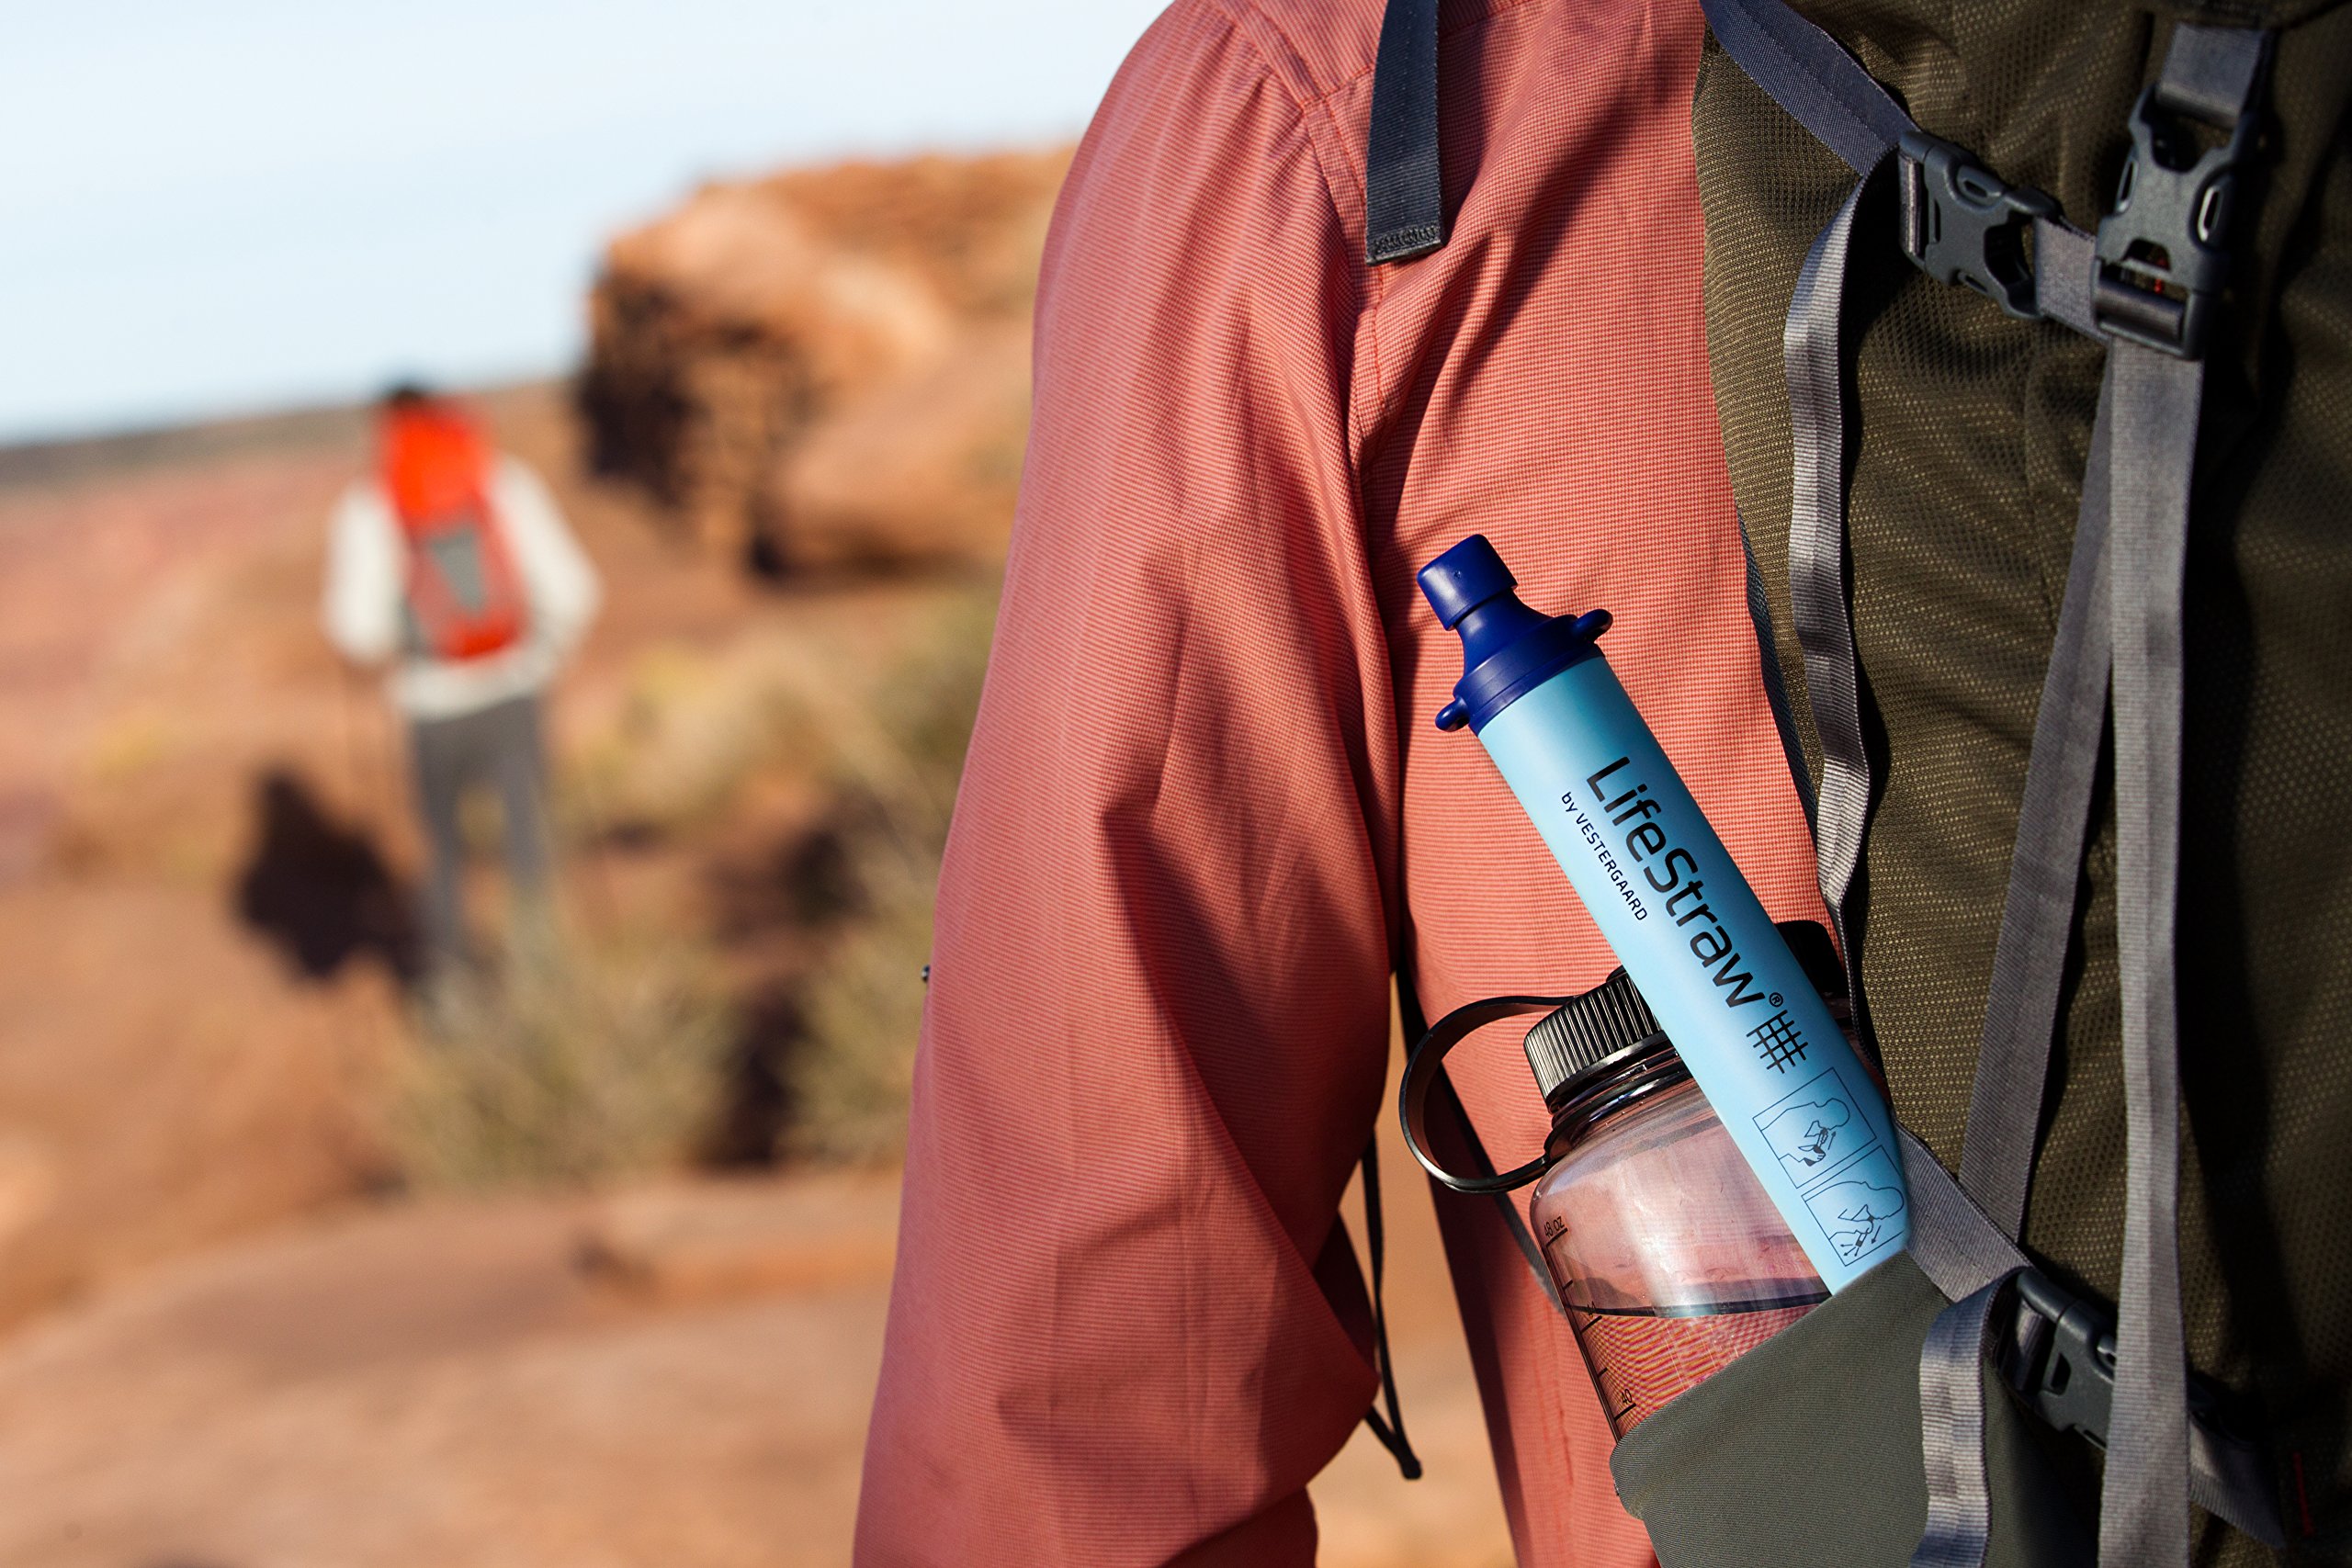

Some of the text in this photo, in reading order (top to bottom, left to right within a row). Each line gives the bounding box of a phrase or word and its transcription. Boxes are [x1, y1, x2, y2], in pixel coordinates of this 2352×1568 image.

[1561, 791, 1648, 921] by VESTERGAARD
[1544, 1222, 1554, 1238] 48
[1621, 1388, 1633, 1404] 40
